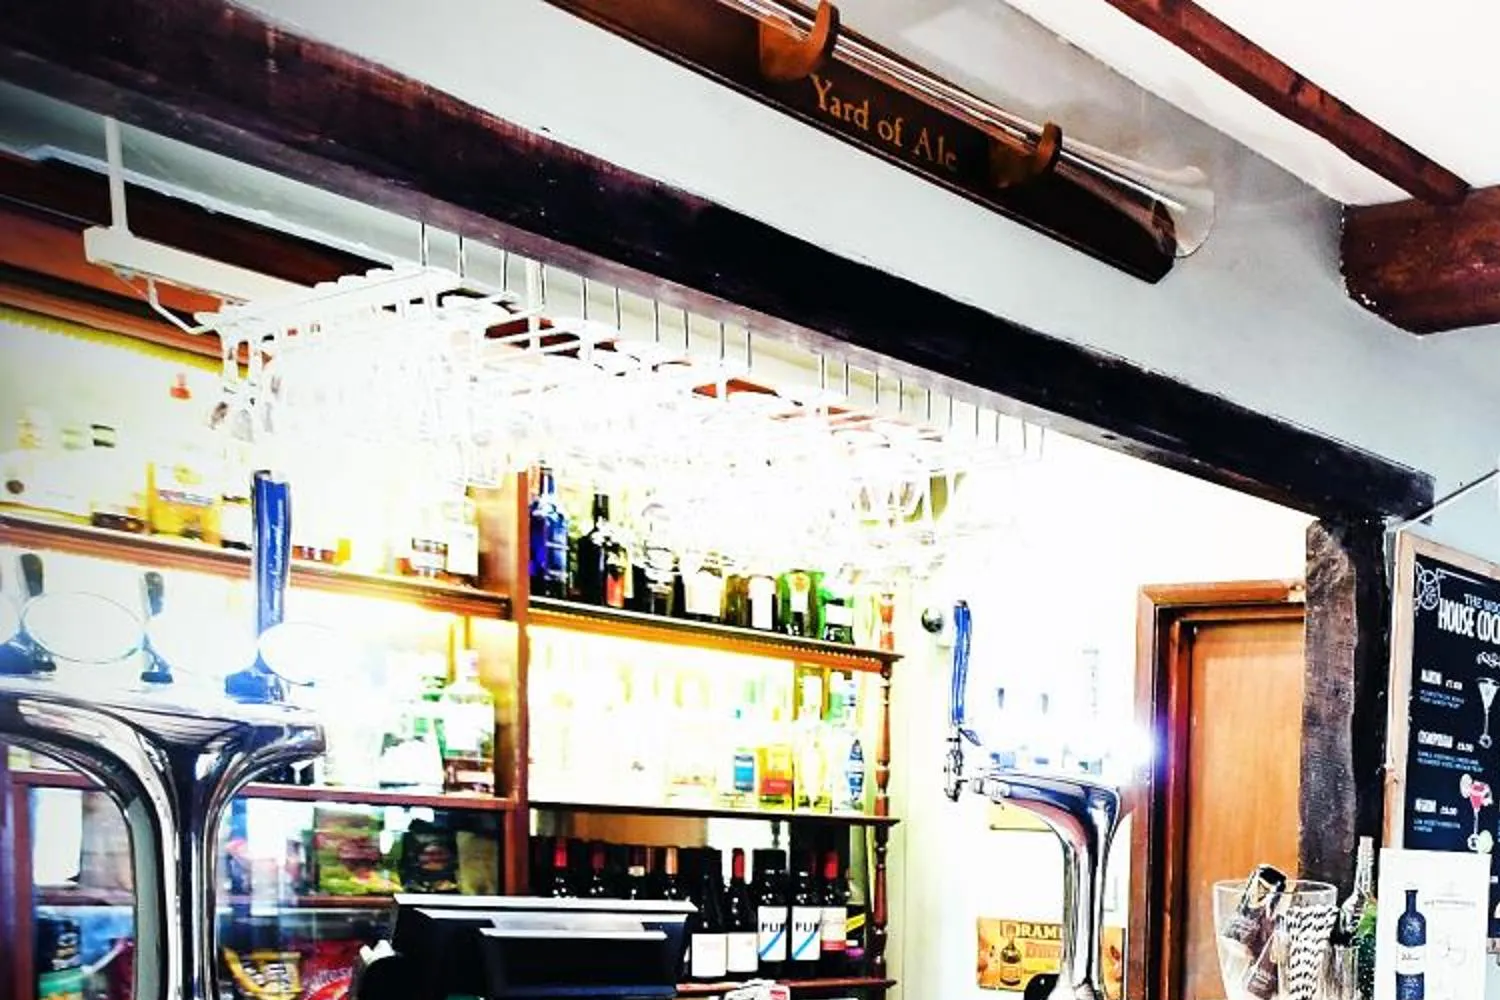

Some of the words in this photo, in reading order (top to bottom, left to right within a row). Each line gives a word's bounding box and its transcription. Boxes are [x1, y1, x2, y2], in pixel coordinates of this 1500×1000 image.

[808, 74, 870, 132] Yard
[876, 118, 904, 146] of
[911, 128, 958, 173] Ale
[1438, 598, 1475, 638] HOUSE
